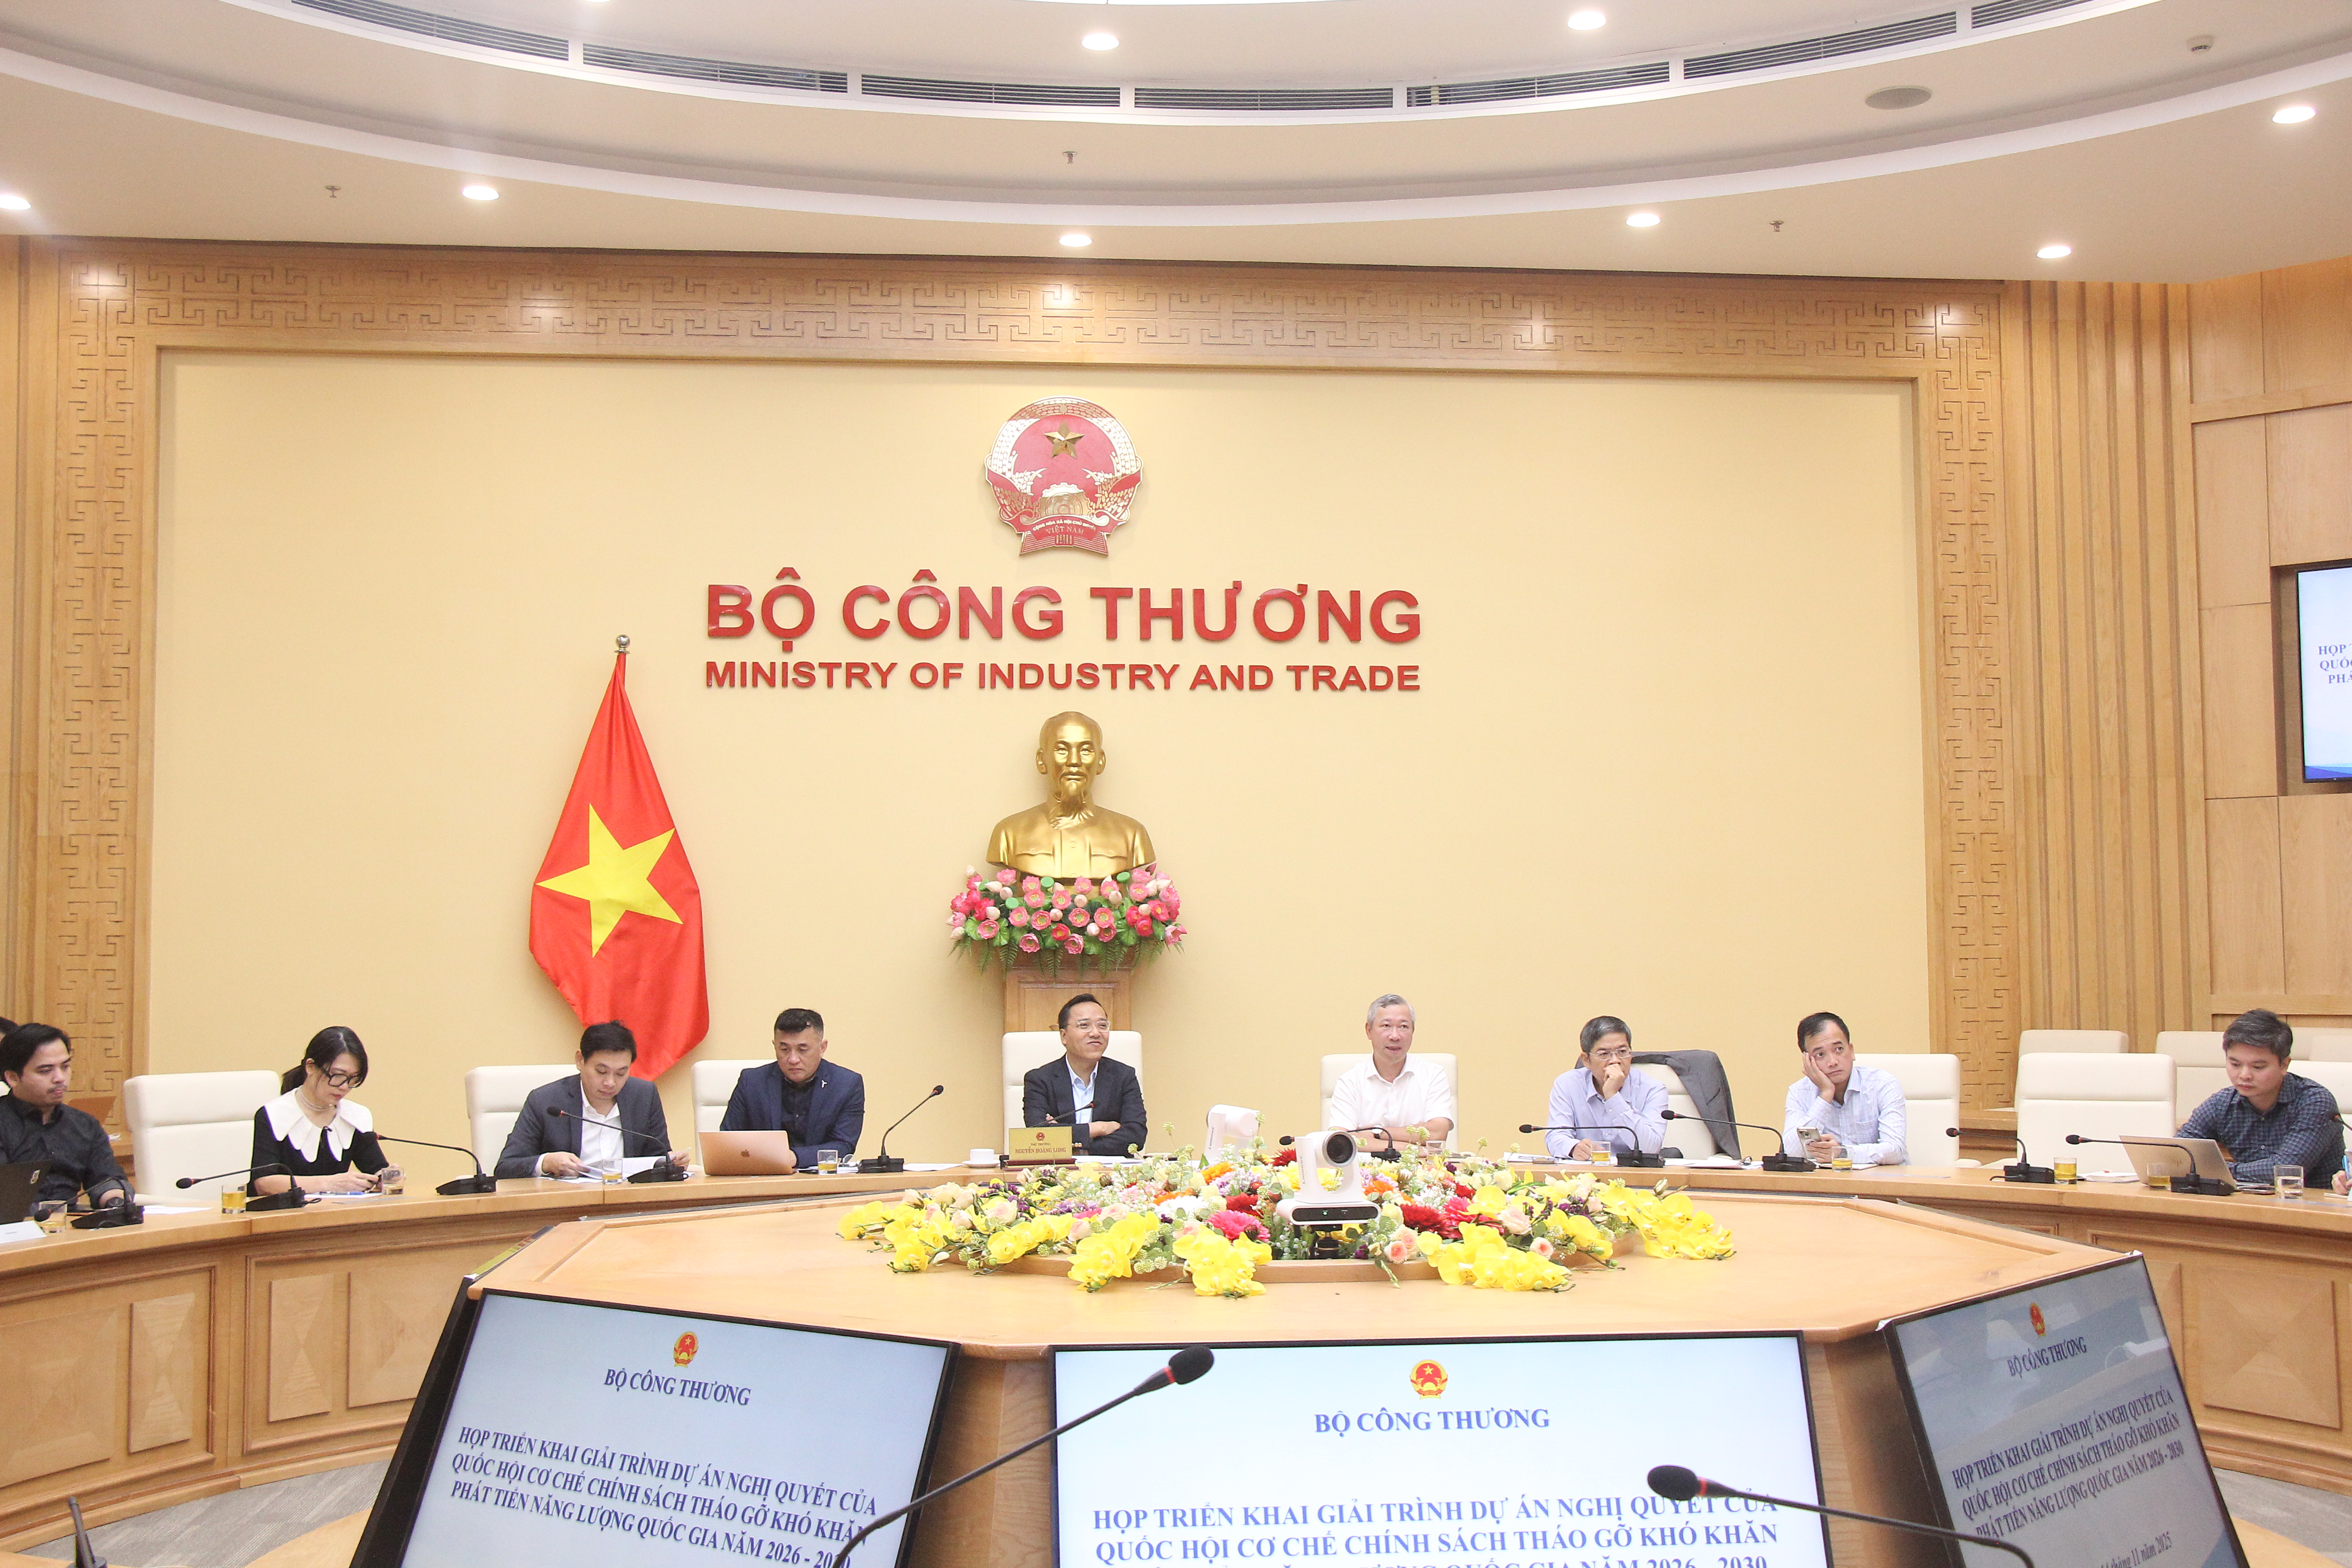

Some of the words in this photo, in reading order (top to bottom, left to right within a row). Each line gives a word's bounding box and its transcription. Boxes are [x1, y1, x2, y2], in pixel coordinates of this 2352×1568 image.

[1033, 523, 1045, 531] CỘNG
[1045, 525, 1064, 534] VIỆT
[1066, 526, 1085, 534] NAM
[707, 567, 815, 653] BỘ
[843, 568, 1064, 641] CÔNG
[1090, 580, 1421, 643] THƯƠNG
[2318, 644, 2346, 657] HỌP
[2319, 656, 2352, 671] QUỐ
[706, 661, 898, 688] MINISTRY
[910, 662, 964, 689] OF
[979, 662, 1180, 690] INDUSTRY
[1189, 664, 1274, 691] AND
[1286, 665, 1421, 691] TRADE
[2007, 1355, 2022, 1378] BỘ
[2022, 1348, 2049, 1371] CÔNG
[2048, 1337, 2087, 1362] THƯƠNG
[604, 1367, 627, 1392] BỘ
[630, 1369, 676, 1394] CÔNG
[679, 1379, 751, 1405] THƯƠNG
[1314, 1411, 1350, 1437] BỘ
[1357, 1407, 1431, 1431] CÔNG
[1437, 1407, 1549, 1430] THƯƠNG
[1952, 1465, 1974, 1490] HỌP
[1974, 1450, 2005, 1480] TRIỂN
[2004, 1442, 2031, 1467] KHAI
[2031, 1431, 2053, 1456] GIẢI
[2051, 1423, 2080, 1449] TRÌNH
[2079, 1416, 2094, 1439] DỰ
[2093, 1410, 2107, 1432] ÁN
[2106, 1405, 2130, 1425] NGHỊ
[2128, 1392, 2155, 1421] QUYẾT
[2156, 1386, 2173, 1406] CỦA
[458, 1426, 490, 1450] HỌP
[492, 1431, 537, 1455] TRIỂN
[538, 1440, 579, 1462] KHAI
[581, 1446, 616, 1469] GIẢI
[619, 1452, 670, 1478] TRÌNH
[671, 1463, 699, 1487] DỰ
[698, 1463, 725, 1488] ÁN
[725, 1472, 773, 1501] NGHỊ
[775, 1480, 837, 1508] QUYẾT
[840, 1489, 876, 1515] CỦA
[1962, 1488, 1992, 1520] QUỐC
[1992, 1481, 2012, 1506] HỘI
[2012, 1474, 2027, 1496] CƠ
[2028, 1462, 2048, 1490] CHẾ
[2047, 1455, 2078, 1481] CHÍNH
[2077, 1445, 2102, 1468] SÁCH
[2100, 1432, 2125, 1459] THÁO
[2137, 1418, 2157, 1443] KHÓ
[2156, 1411, 2180, 1436] KHĂN
[2027, 1497, 2055, 1522] NĂNG
[2053, 1481, 2087, 1509] LƯỢNG
[2087, 1468, 2112, 1497] QUỐC
[2112, 1465, 2129, 1483] GIA
[2127, 1455, 2148, 1476] NĂM
[2146, 1448, 2164, 1469] 2026
[2166, 1440, 2184, 1460] 2030
[452, 1452, 495, 1475] QUỐC
[495, 1459, 526, 1484] HỘI
[527, 1467, 552, 1486] CƠ
[552, 1470, 586, 1493] CHẾ
[588, 1477, 641, 1503] CHÍNH
[642, 1485, 688, 1511] SÁCH
[691, 1495, 737, 1520] THÁO
[741, 1504, 770, 1526] GỠ
[770, 1511, 812, 1534] KHÓ
[451, 1480, 492, 1503] PHÁT
[493, 1486, 529, 1510] TIỂN
[530, 1494, 574, 1519] NĂNG
[576, 1504, 635, 1531] LƯỢNG
[637, 1516, 686, 1541] QUỐC
[689, 1526, 717, 1548] GIA
[721, 1530, 764, 1557] NĂM
[765, 1541, 803, 1564] 2026
[813, 1550, 850, 1568] 200
[1093, 1509, 1148, 1534] HỌP
[1153, 1502, 1234, 1527] TRIỂN
[1242, 1505, 1309, 1525] KHAI
[1317, 1498, 1374, 1524] GIẢI
[1380, 1497, 1464, 1522] TRÌNH
[1470, 1497, 1509, 1524] DỰ
[1515, 1494, 1549, 1518] ÁN
[1557, 1497, 1622, 1521] NGHỊ
[1096, 1535, 1173, 1565] QUỐC
[1181, 1536, 1230, 1564] HỘI
[1237, 1536, 1276, 1558] CƠ
[1283, 1530, 1337, 1556] CHẾ
[1345, 1529, 1431, 1554] CHÍNH
[1438, 1527, 1506, 1552] SÁCH
[1514, 1524, 1587, 1550] THÁO
[1594, 1523, 1632, 1548] GỠ
[1639, 1521, 1697, 1546] KHÓ
[1703, 1519, 1777, 1544] KHĂN
[2156, 1531, 2172, 1553] 2025
